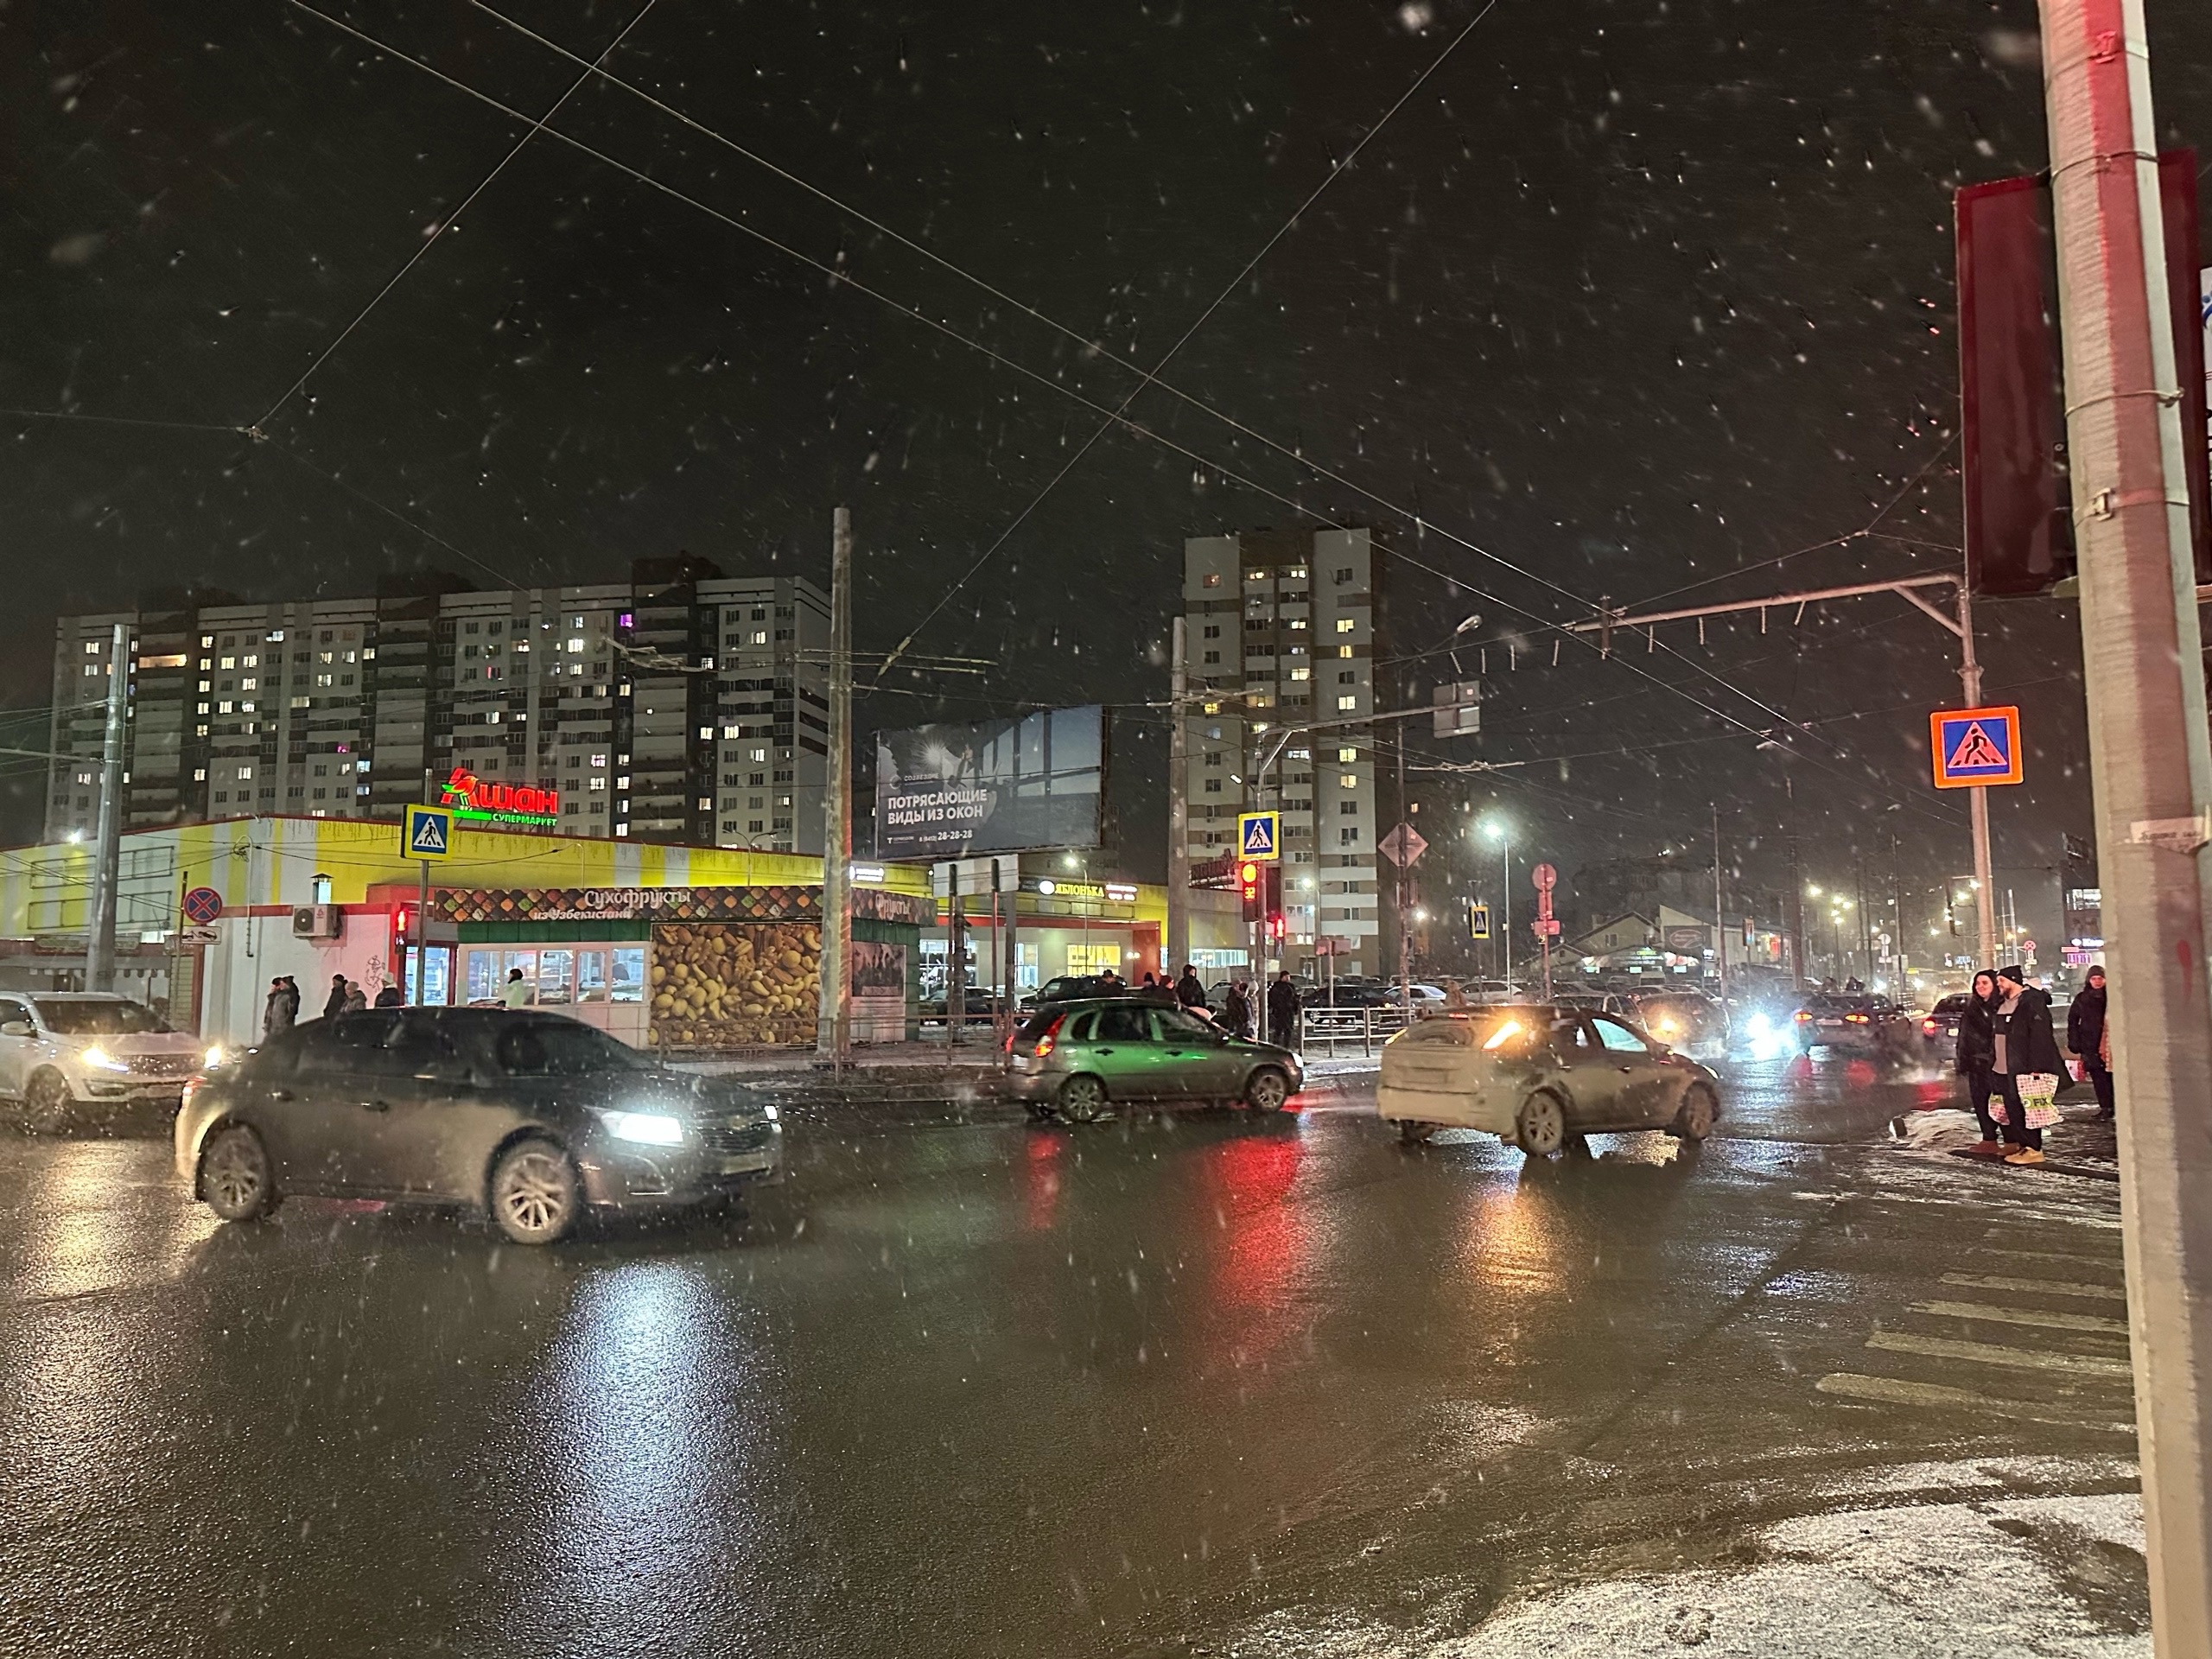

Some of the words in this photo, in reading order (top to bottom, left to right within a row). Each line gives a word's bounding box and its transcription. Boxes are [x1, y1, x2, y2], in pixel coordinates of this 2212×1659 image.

[887, 789, 988, 810] ПОТРЯСАЮЩИЕ
[492, 813, 557, 827] СУПЕРМАРКЕТ
[887, 810, 925, 825] ВИДЫ
[927, 808, 944, 822] ИЗ
[946, 804, 983, 820] ОКОН
[938, 830, 973, 841] 28-28-28
[1055, 883, 1105, 898] ЯБЛОНЬКА
[584, 889, 691, 910] Сухофрукты
[534, 911, 549, 921] из
[550, 907, 633, 921] Узбекистана
[2032, 1097, 2049, 1107] FIX
